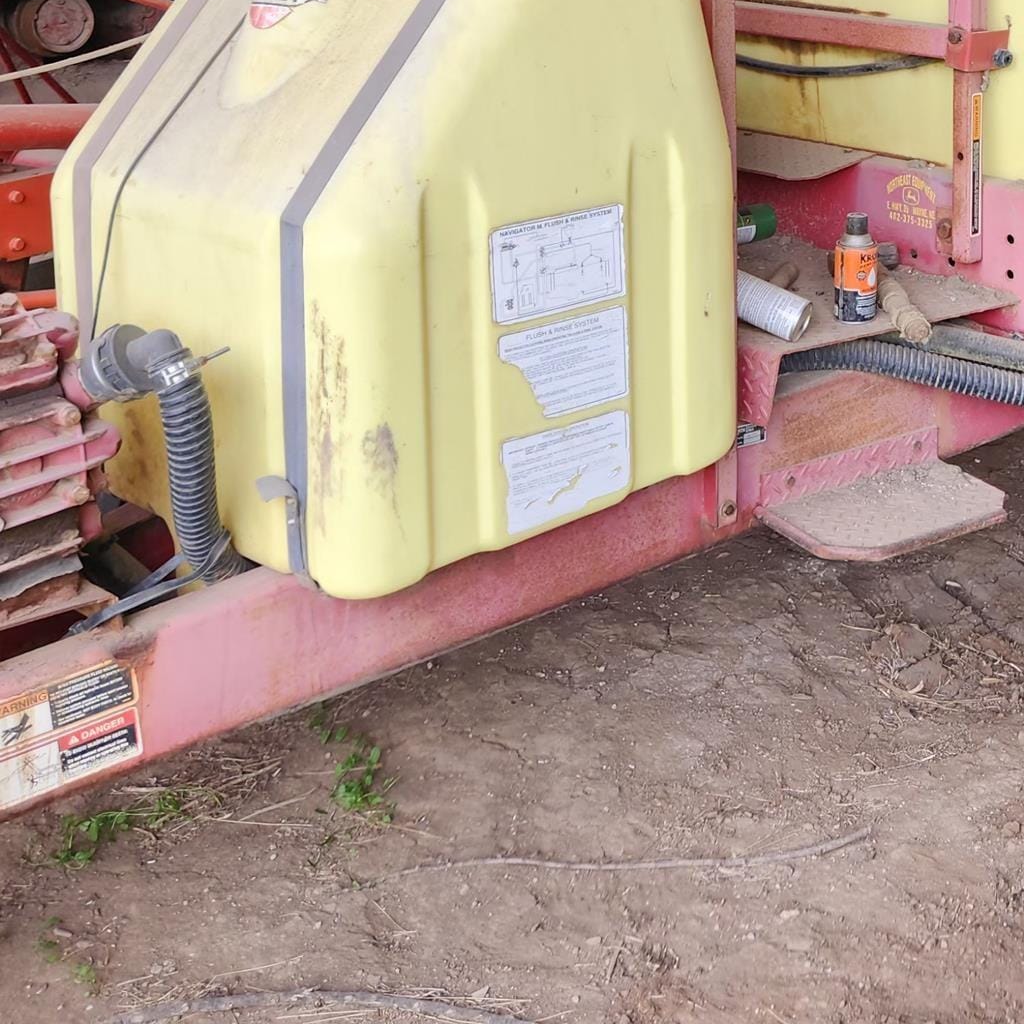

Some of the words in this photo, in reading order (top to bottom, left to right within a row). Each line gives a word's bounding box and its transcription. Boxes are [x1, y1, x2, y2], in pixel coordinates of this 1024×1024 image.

[499, 224, 536, 237] NAVIGATOR
[544, 218, 564, 229] FLUSH
[570, 213, 588, 223] RINSE
[589, 208, 613, 218] SYSTEM
[525, 330, 547, 341] FLUSH
[554, 323, 573, 334] RINSE
[574, 317, 600, 329] SYSTEM
[81, 717, 125, 740] DANGER
